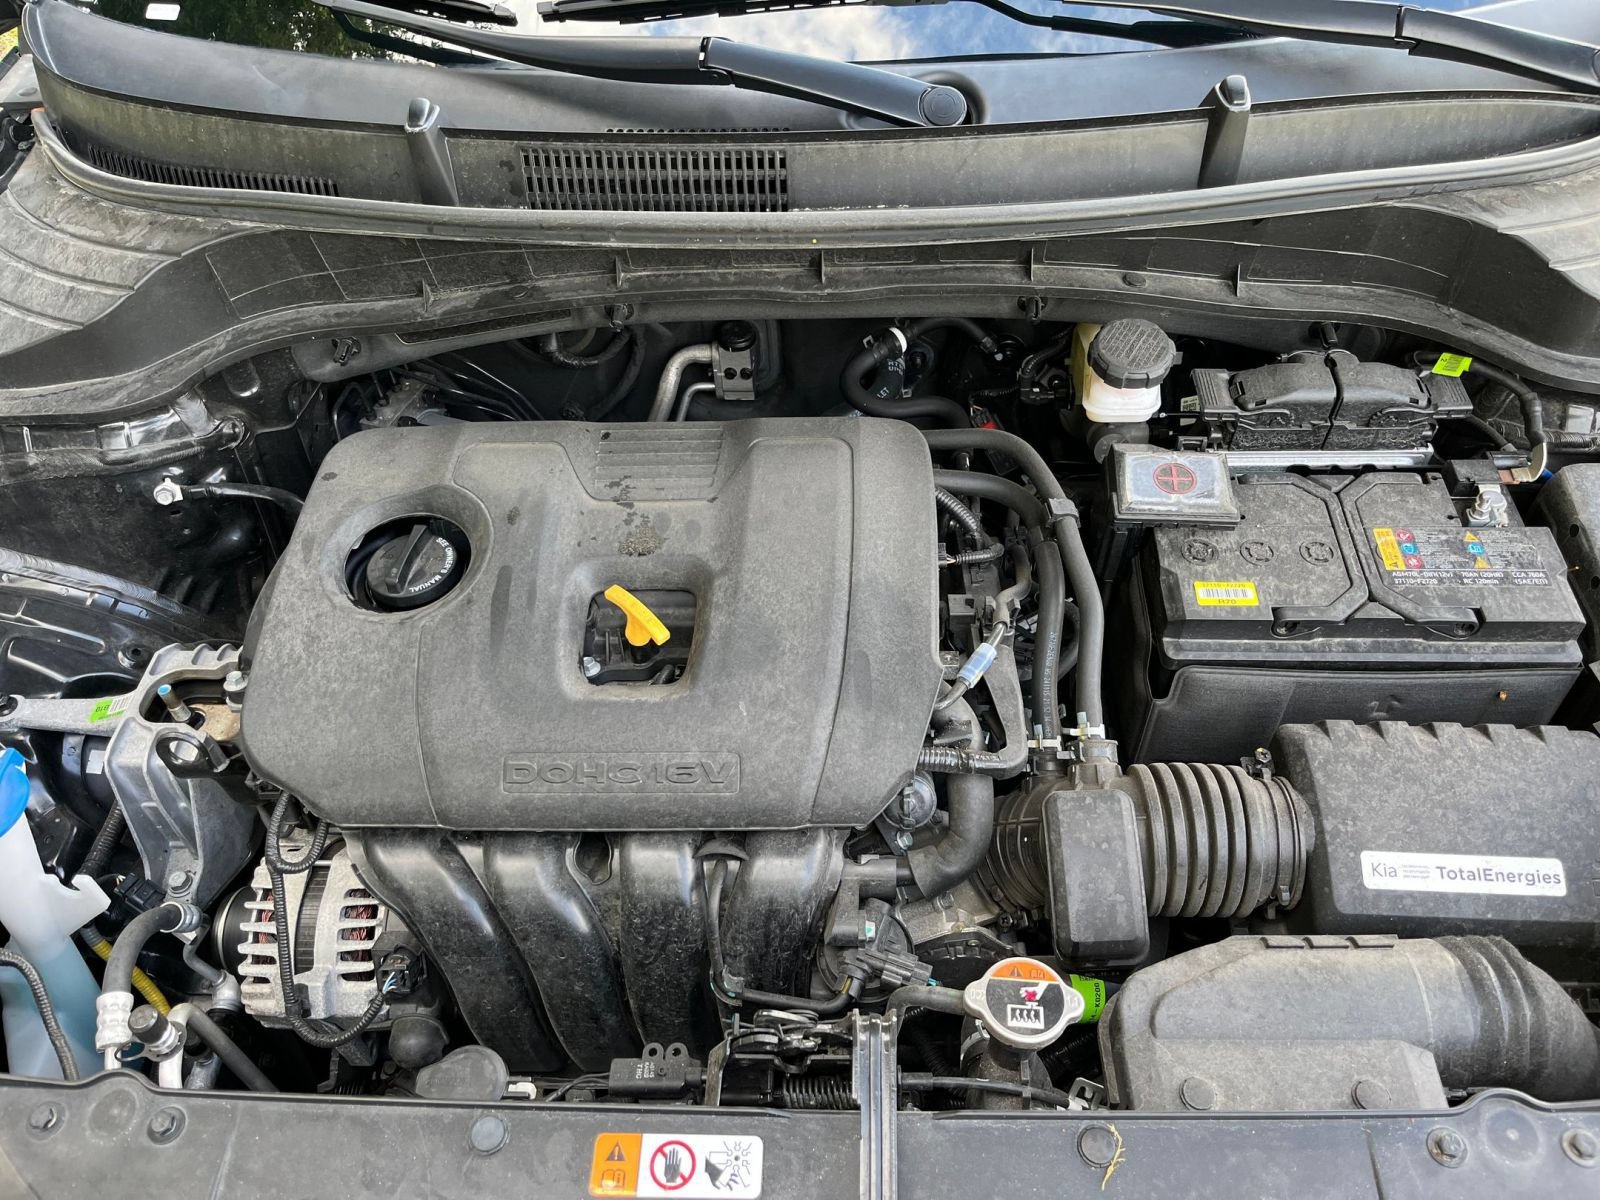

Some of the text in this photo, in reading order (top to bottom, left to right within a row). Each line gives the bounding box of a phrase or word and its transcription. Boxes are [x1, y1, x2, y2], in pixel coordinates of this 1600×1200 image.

[436, 537, 449, 548] SEE
[409, 574, 442, 593] MANUAL
[505, 761, 738, 785] DOHC 16V
[1371, 862, 1397, 878] Kia
[1436, 865, 1561, 886] TotalEnergies
